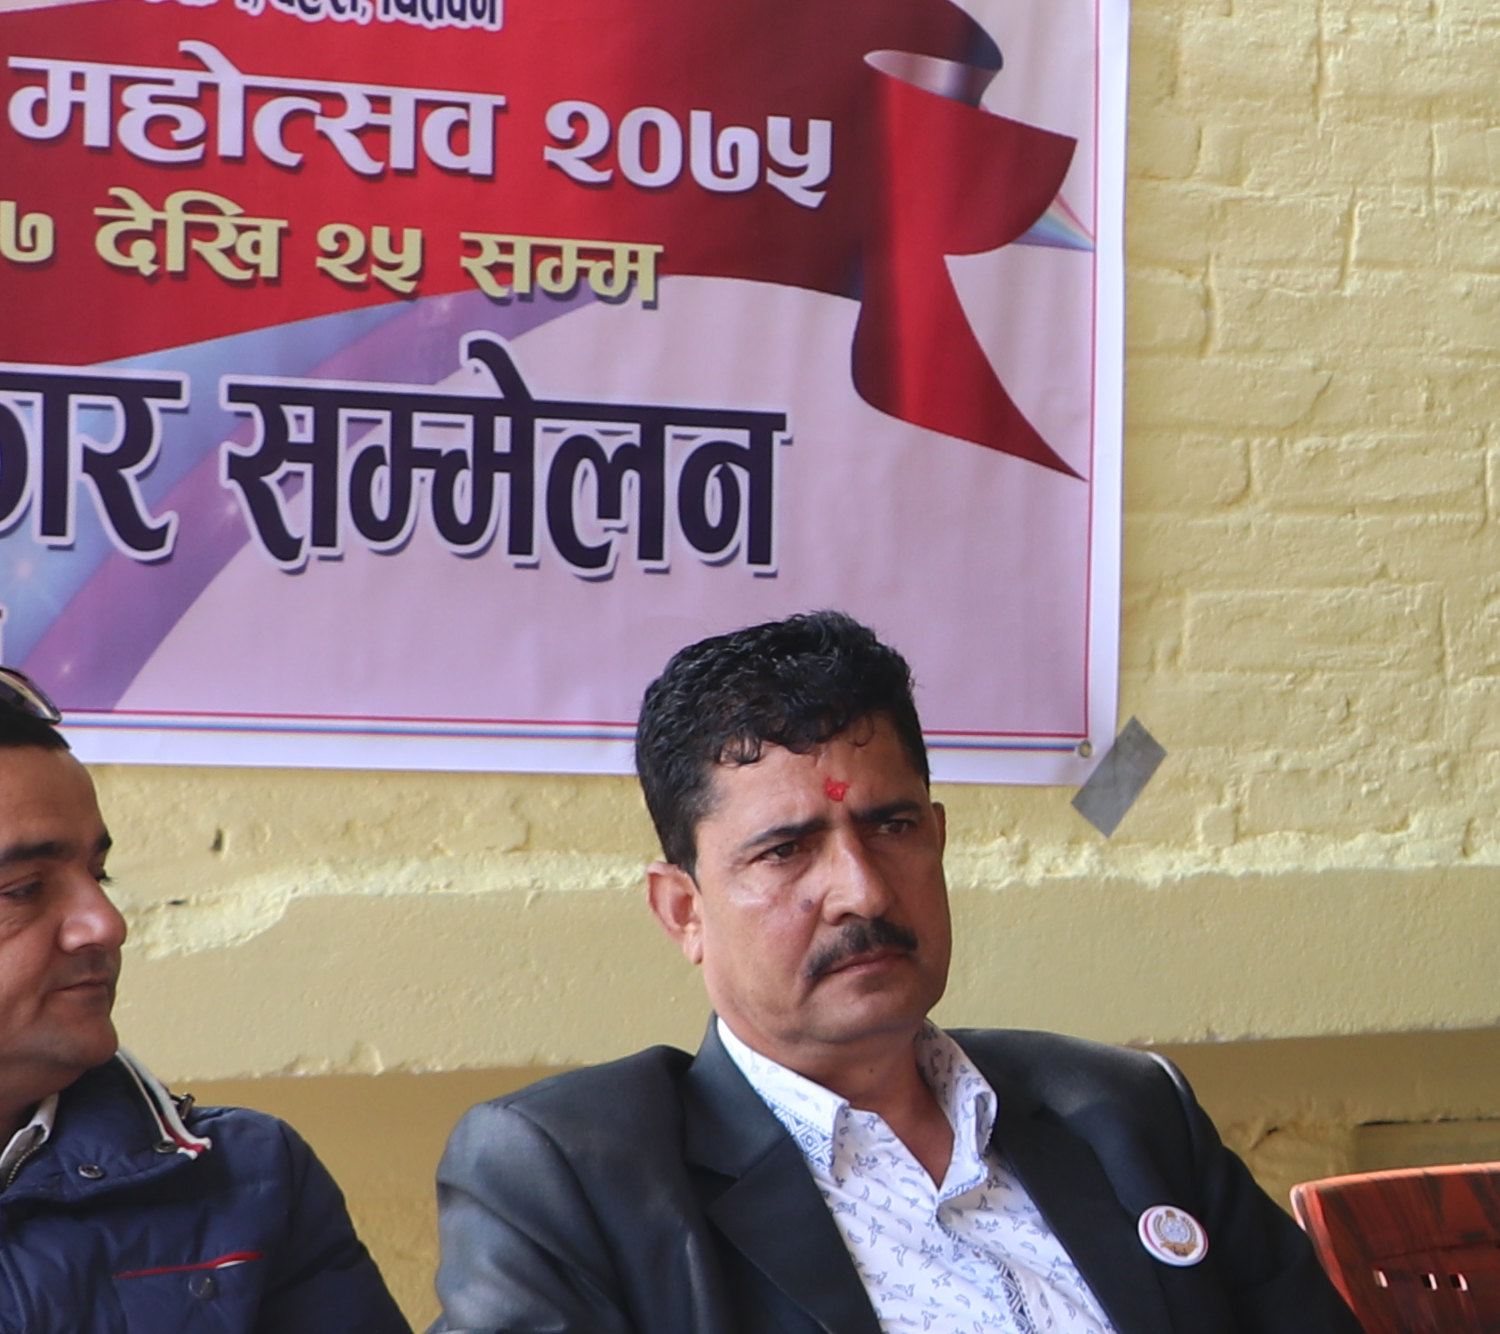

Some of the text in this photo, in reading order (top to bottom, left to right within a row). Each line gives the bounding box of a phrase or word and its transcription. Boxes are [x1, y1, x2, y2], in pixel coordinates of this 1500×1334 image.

[7, 40, 506, 178] महोत्सव
[543, 99, 834, 209] २०७५
[93, 186, 287, 280] देखि
[315, 220, 424, 294] २५
[460, 231, 663, 302] सम्म
[227, 337, 788, 569] सम्मेलन
